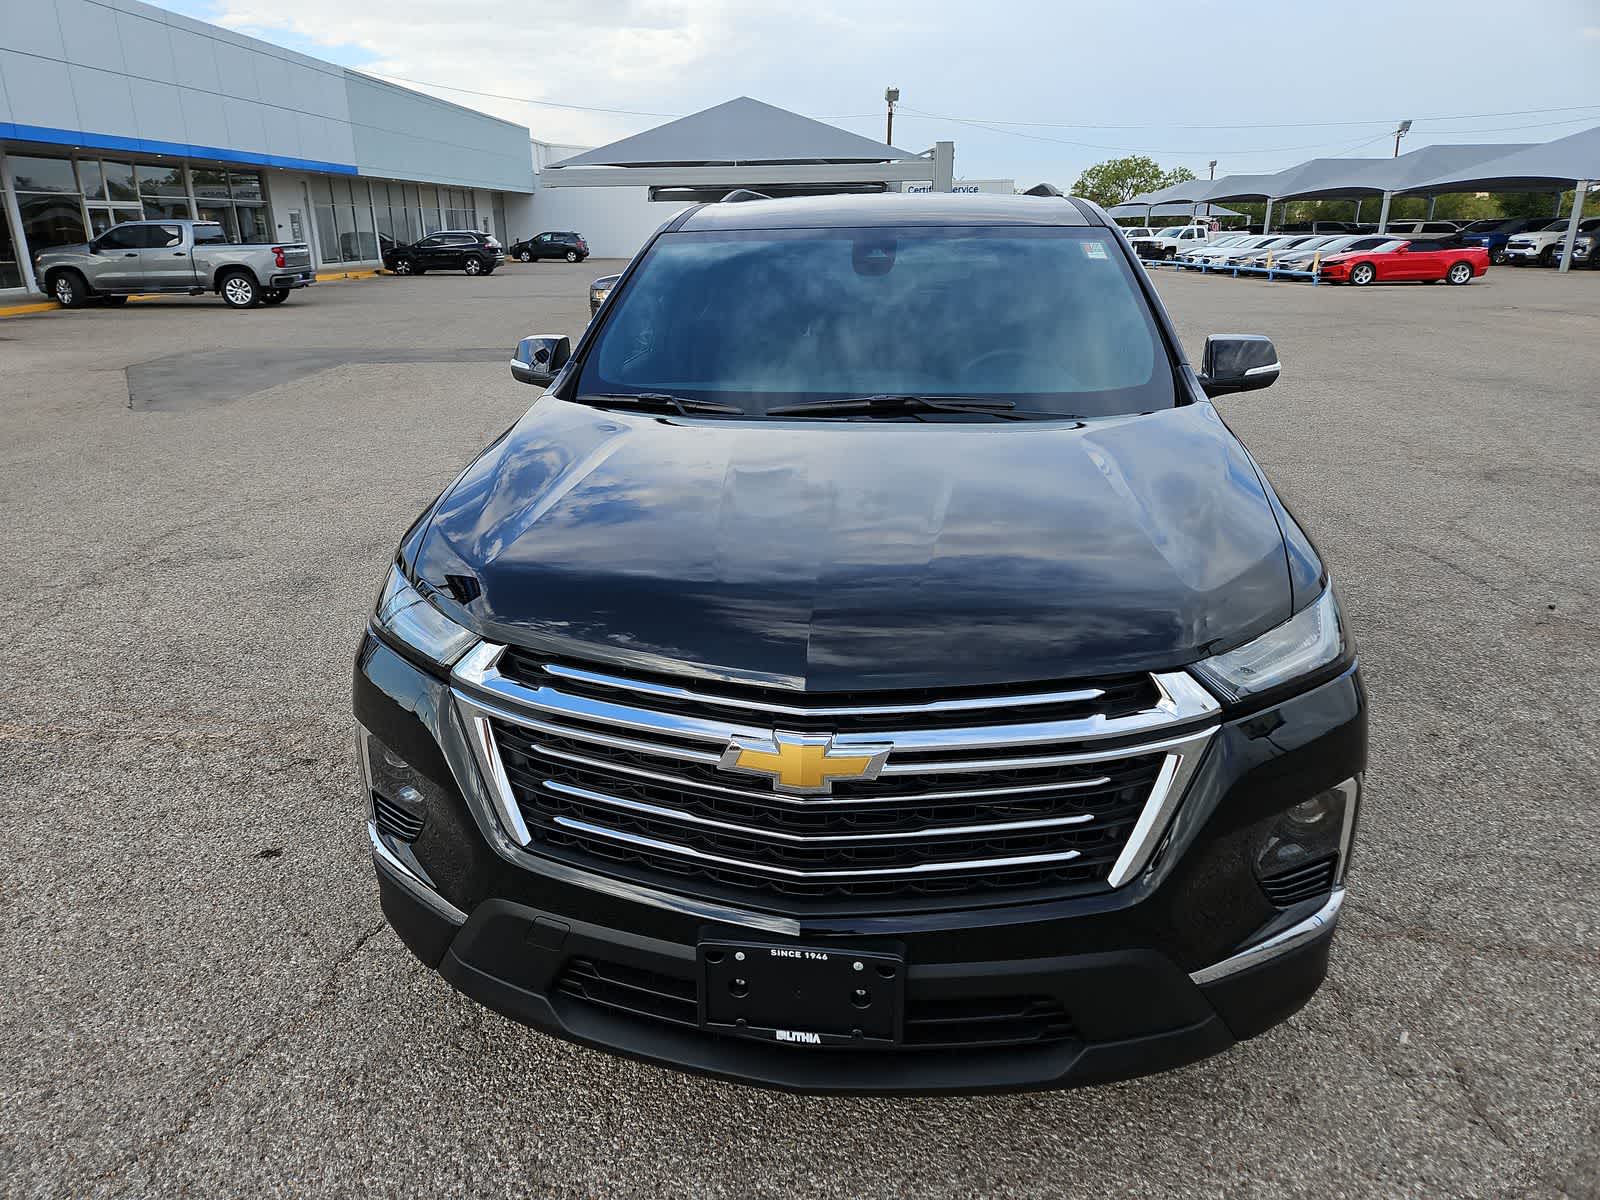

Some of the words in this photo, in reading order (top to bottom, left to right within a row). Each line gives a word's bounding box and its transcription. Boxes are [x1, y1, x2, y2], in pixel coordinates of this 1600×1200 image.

[770, 949, 801, 958] SINCE
[804, 952, 828, 960] 1946
[786, 1031, 821, 1044] LITHIA
